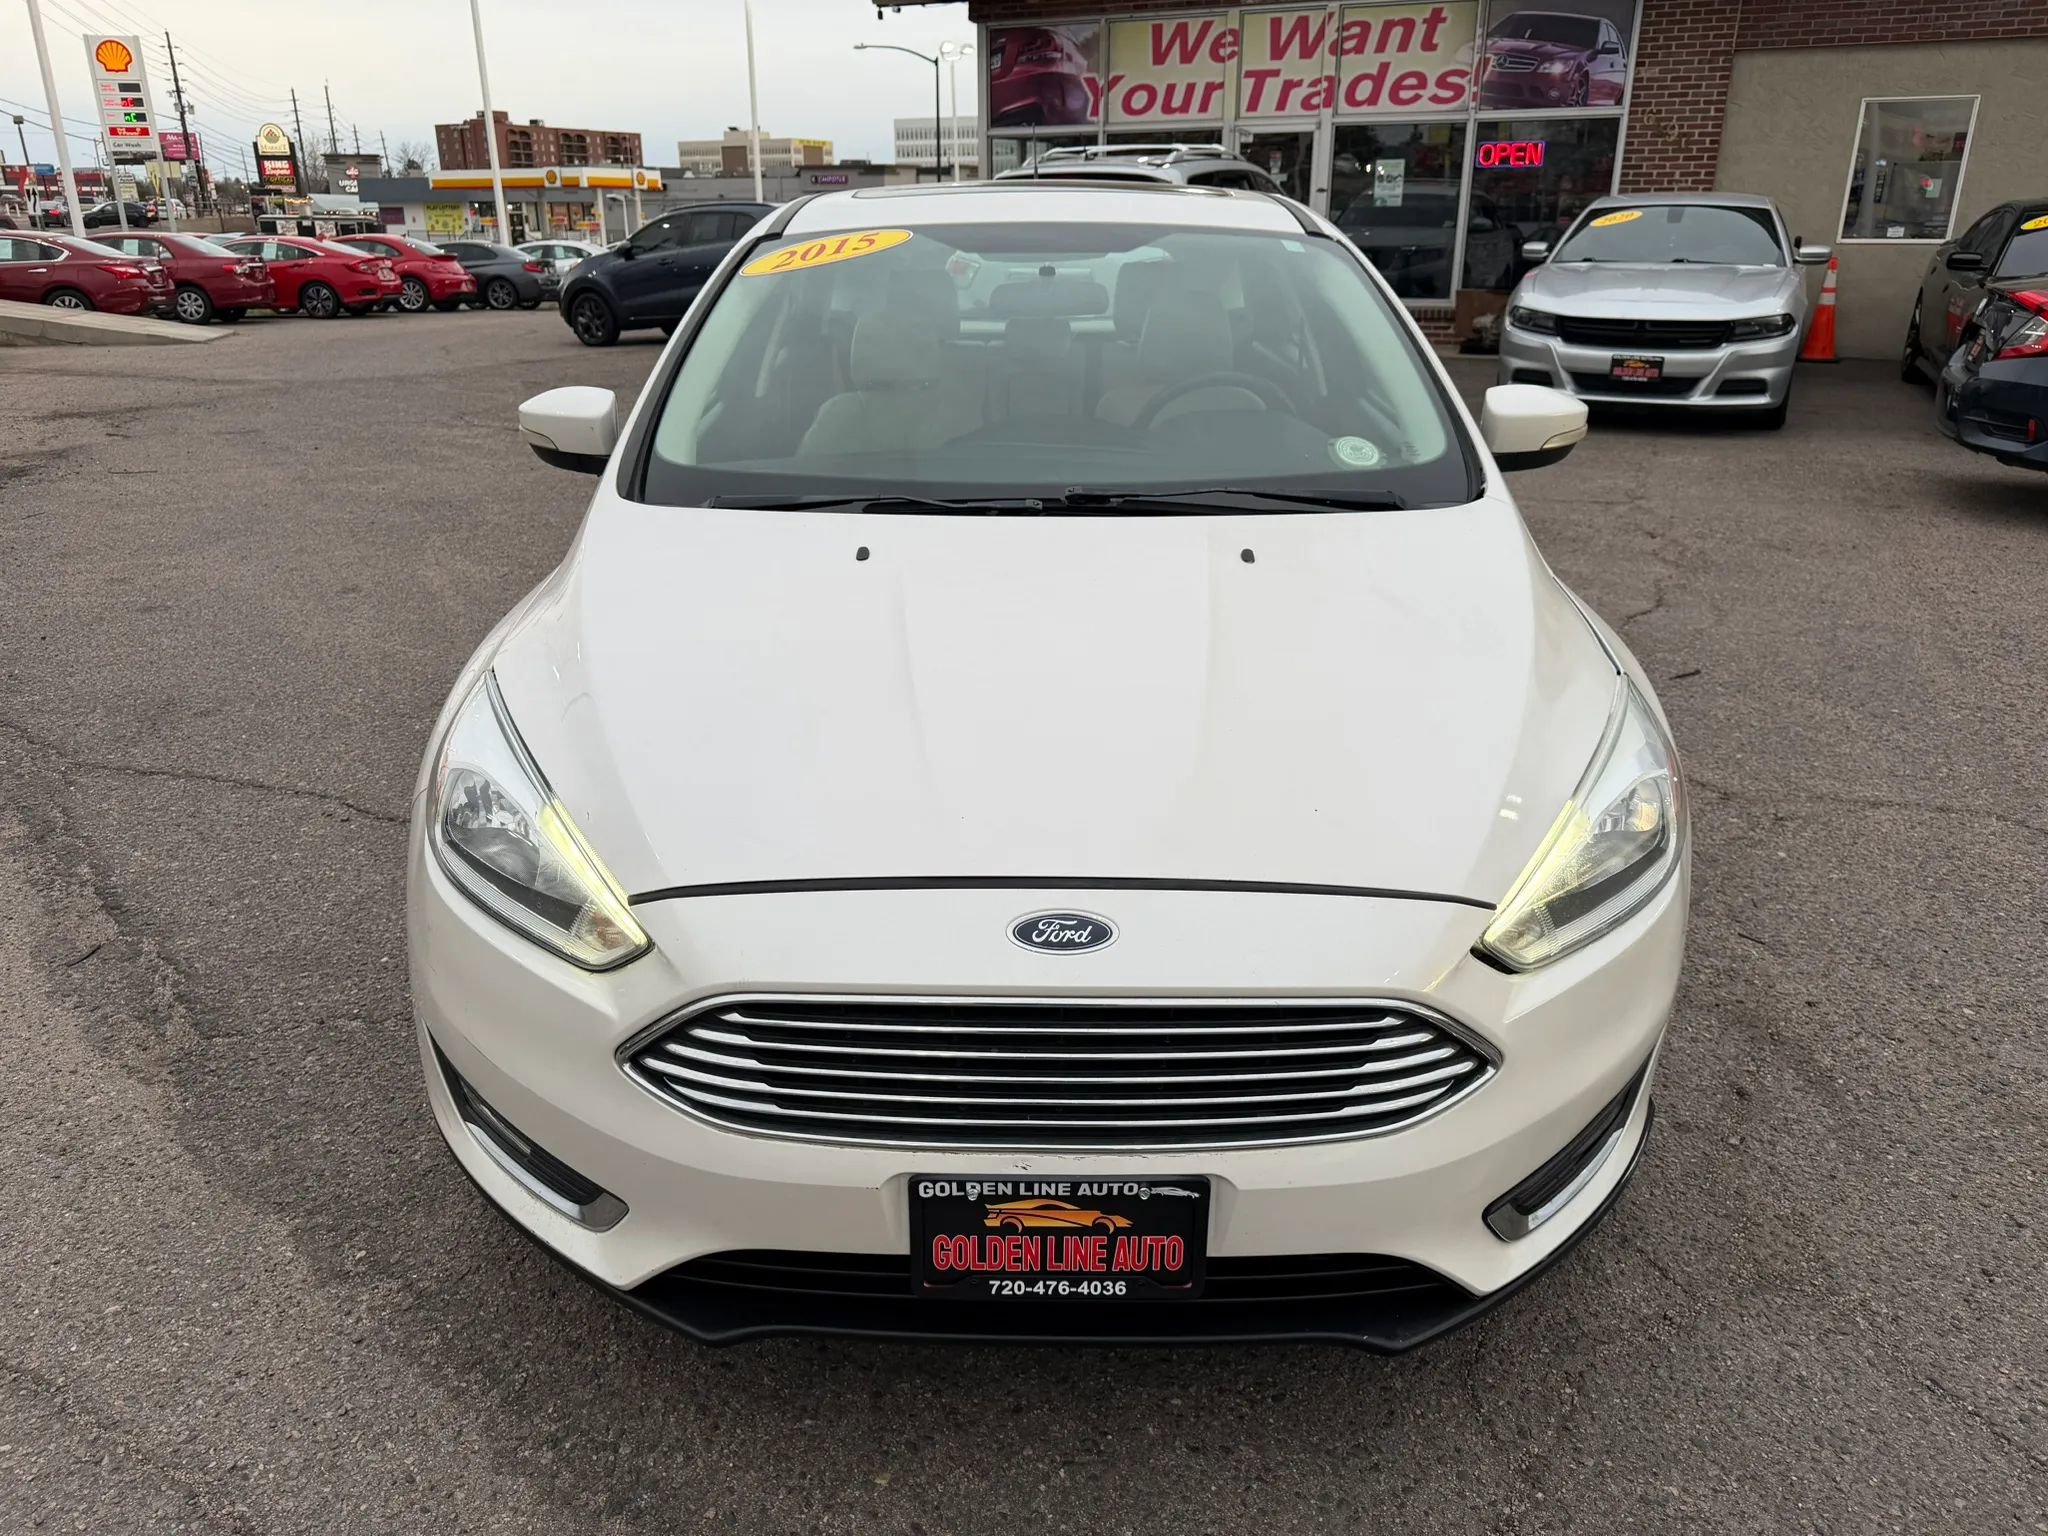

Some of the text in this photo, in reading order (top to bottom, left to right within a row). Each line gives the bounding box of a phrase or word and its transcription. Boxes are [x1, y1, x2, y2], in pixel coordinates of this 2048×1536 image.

[1151, 6, 1448, 66] We Want
[1082, 57, 1491, 118] Your Trades!
[263, 160, 289, 168] KING
[1478, 143, 1543, 167] OPEN
[769, 232, 881, 270] 2015
[1032, 919, 1093, 943] Ford
[1019, 1182, 1071, 1197] LINE
[1077, 1182, 1139, 1197] AUTO
[933, 1234, 1185, 1272] GOLDEN LINE AUTO
[989, 1280, 1127, 1295] 720-476-4036
